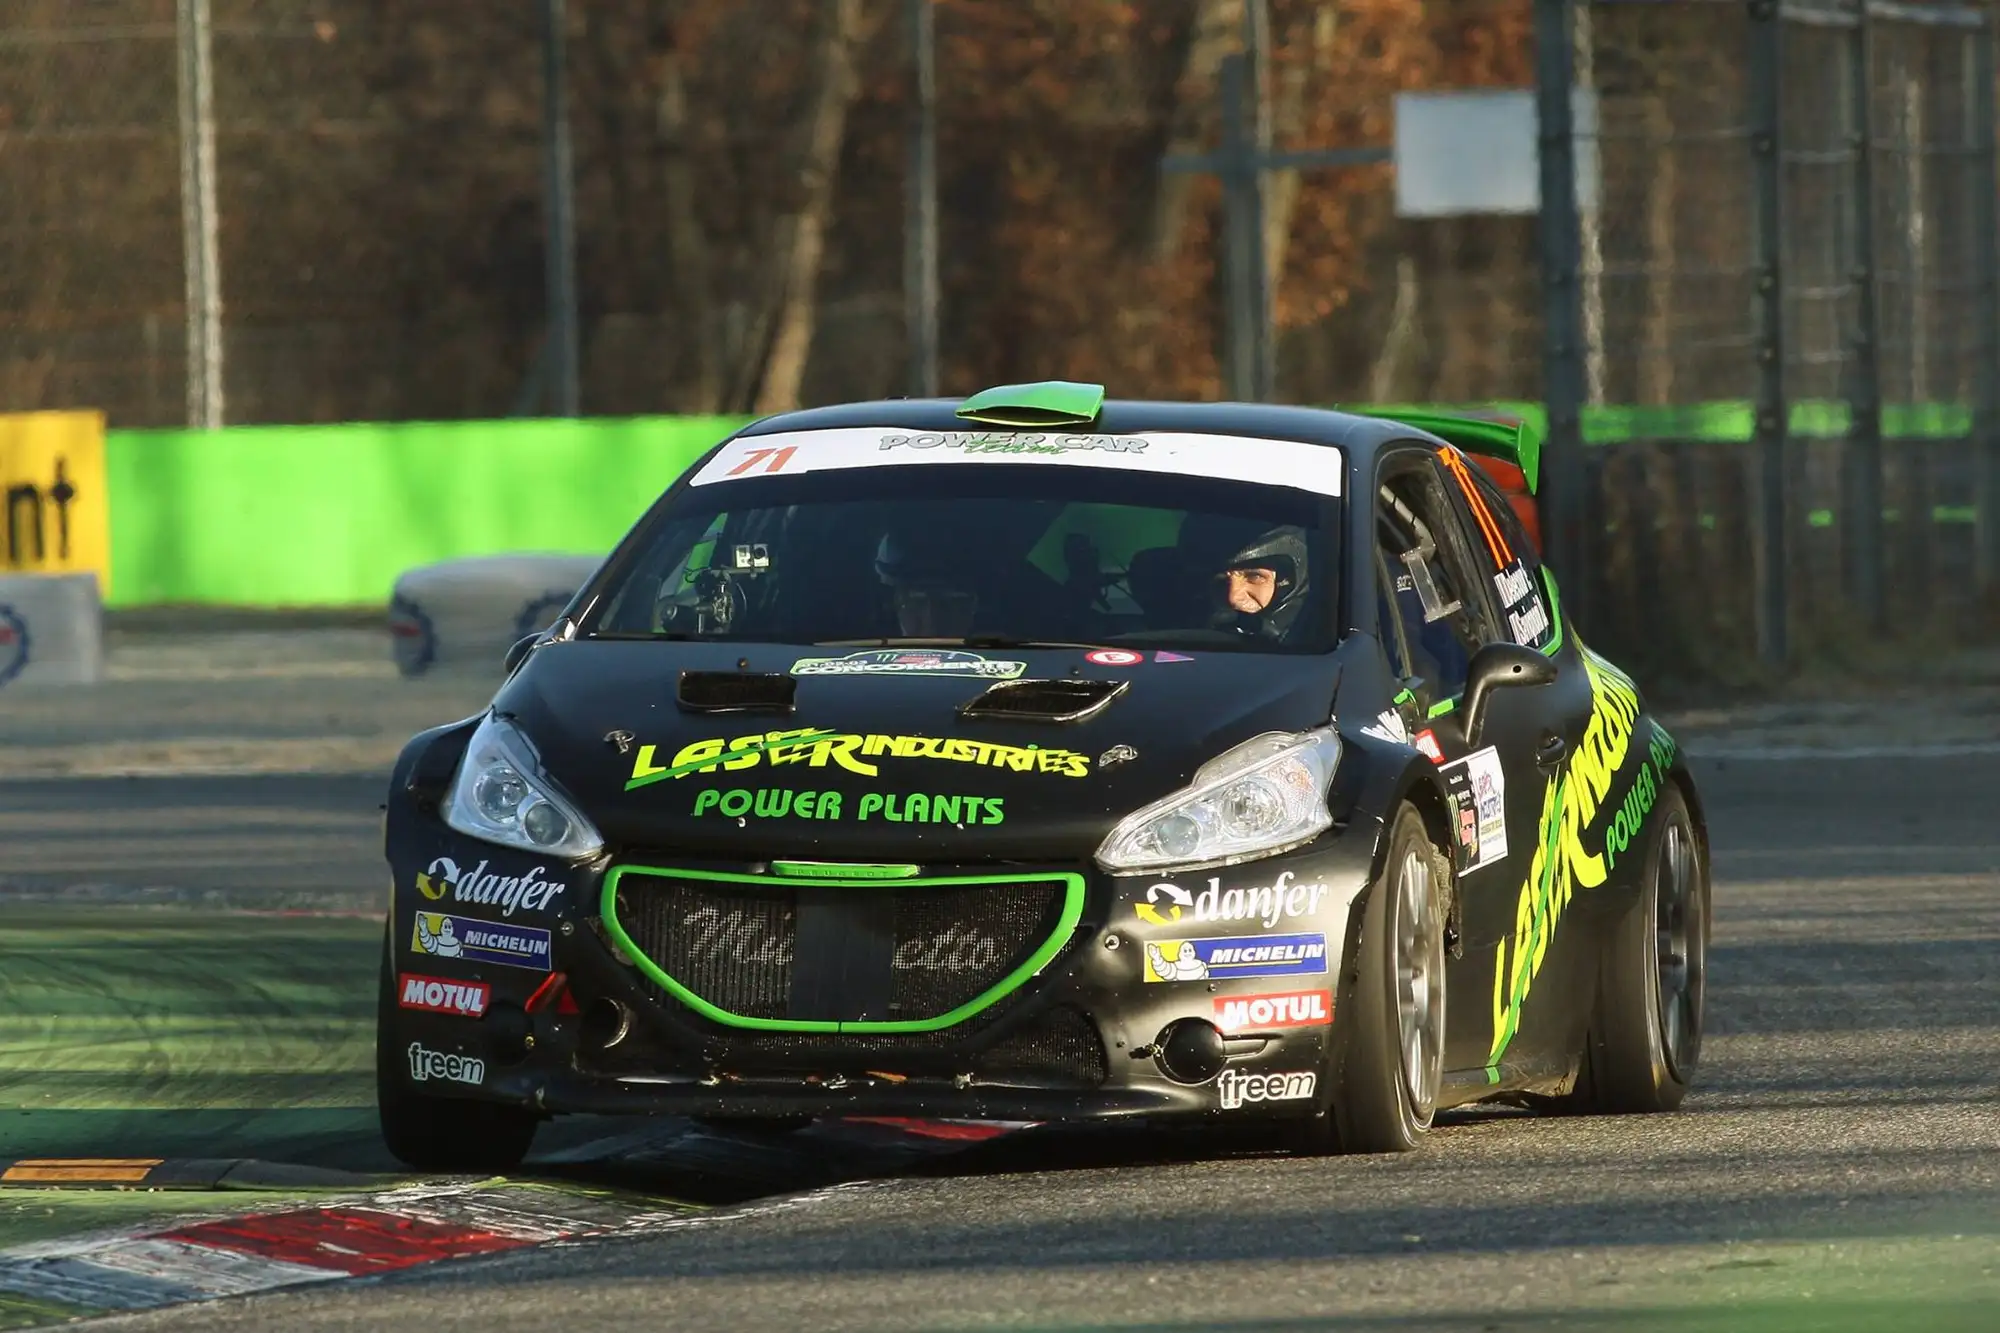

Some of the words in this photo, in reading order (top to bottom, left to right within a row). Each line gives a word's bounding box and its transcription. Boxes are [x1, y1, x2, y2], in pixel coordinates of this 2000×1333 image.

[879, 431, 1047, 451] POWER
[1054, 434, 1150, 454] CAR
[726, 446, 798, 477] 71
[630, 728, 878, 781] LASER
[862, 735, 1089, 777] INDUSTRIES
[694, 789, 841, 820] POWER
[858, 793, 1004, 825] PLANTS
[1606, 762, 1657, 870] POWER
[455, 859, 566, 917] danfer
[1194, 871, 1329, 929] danfer
[464, 930, 548, 955] MICHELIN
[1209, 943, 1325, 964] MICHELIN
[402, 979, 485, 1012] MOTUL
[1219, 994, 1327, 1028] MOTUL
[408, 1042, 485, 1085] freem
[1217, 1069, 1317, 1109] freem
